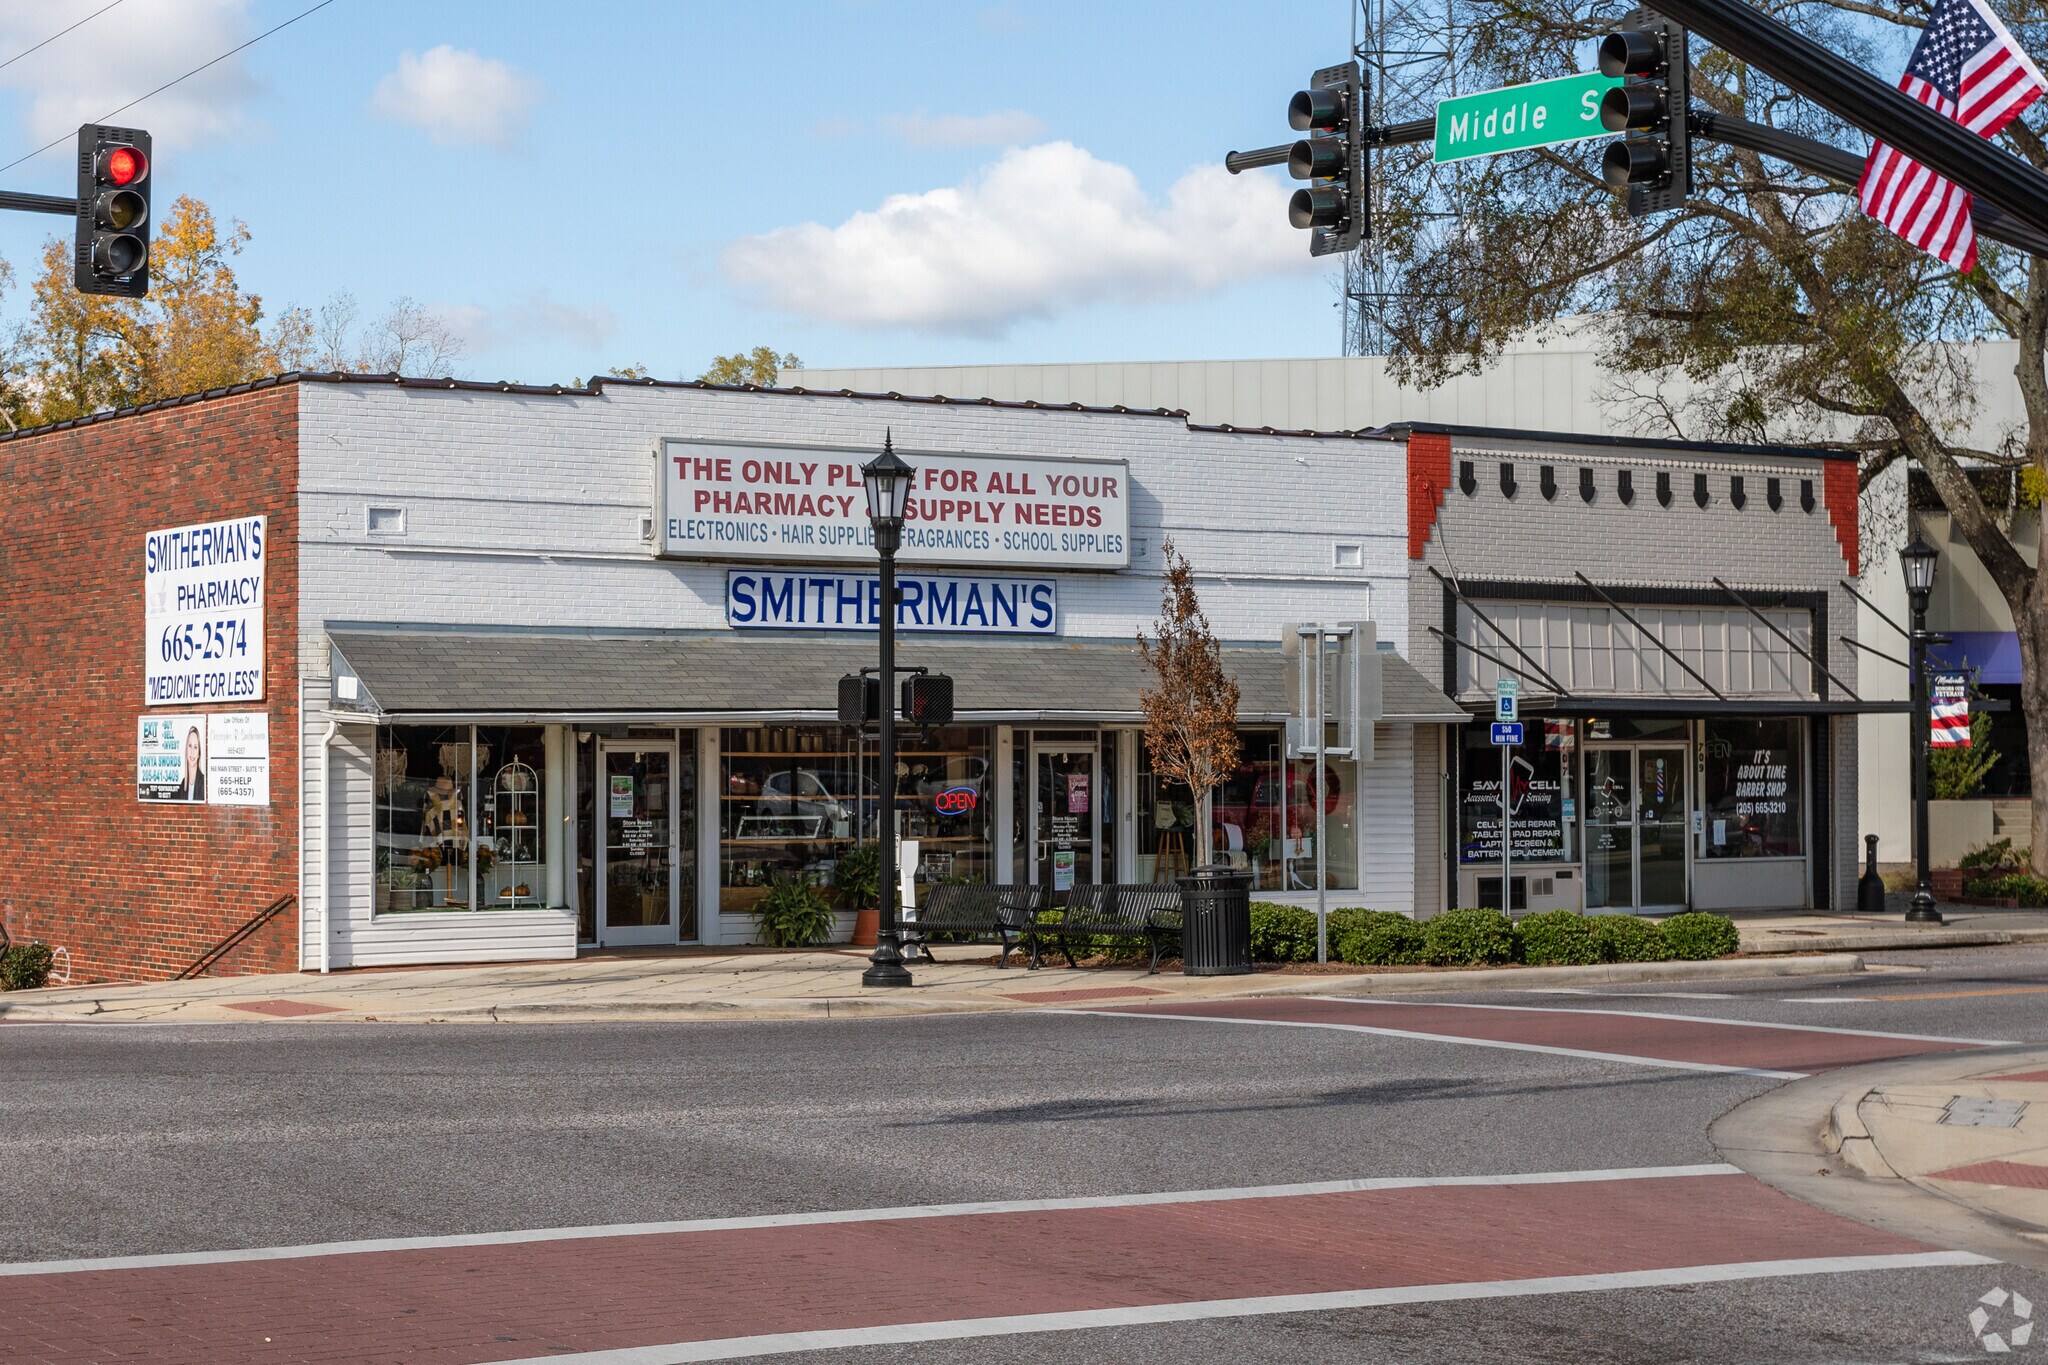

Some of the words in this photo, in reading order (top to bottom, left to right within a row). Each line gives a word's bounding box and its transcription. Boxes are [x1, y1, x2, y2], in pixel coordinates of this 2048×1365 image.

[1449, 101, 1548, 145] Middle
[1580, 87, 1612, 121] S
[673, 456, 732, 482] THE
[741, 460, 819, 485] ONLY
[828, 464, 917, 490] PLE
[924, 468, 978, 493] FOR
[986, 472, 1037, 495] ALL
[1045, 474, 1119, 499] YOUR
[694, 490, 855, 518] PHARMACY
[903, 497, 1006, 524] SUPPLY
[1014, 502, 1103, 528] NEEDS
[668, 518, 768, 543] ELECTRONICS
[781, 523, 815, 544] HAIR
[818, 525, 876, 546] SUPPLIE
[899, 527, 990, 550] FRAGRANCES
[1003, 532, 1058, 551] SCHOOL
[1061, 533, 1123, 554] SUPPLIES
[147, 519, 262, 574] SMITHERMAN'S
[177, 576, 260, 611] PHARMACY
[731, 575, 1053, 629] SMITHERMAN'S
[161, 618, 247, 662] 665-2574
[149, 674, 200, 700] "MEDICINE
[203, 672, 225, 698] FOR
[228, 669, 259, 696] LESS"
[143, 722, 158, 738] EXIT
[1501, 725, 1512, 733] $50
[1495, 734, 1505, 742] MIN
[1506, 734, 1519, 742] FINE
[1753, 749, 1771, 764] IT'S
[1737, 765, 1765, 779] ABOUT
[1766, 765, 1787, 779] TIME
[219, 776, 252, 785] 665-HELP
[1473, 780, 1503, 791] SAV
[217, 787, 255, 798] (665-4357)
[1736, 782, 1765, 797] BARBER
[1766, 781, 1787, 797] SHOP
[935, 793, 976, 810] OPEN
[1526, 792, 1552, 804] Servicing
[1736, 802, 1754, 816] (205)
[1755, 801, 1786, 814] 665-3210
[1527, 820, 1556, 828] REPAIR
[1512, 830, 1531, 838] IPAD
[1480, 840, 1513, 848] LAPTP
[1468, 850, 1503, 858] BATTERY
